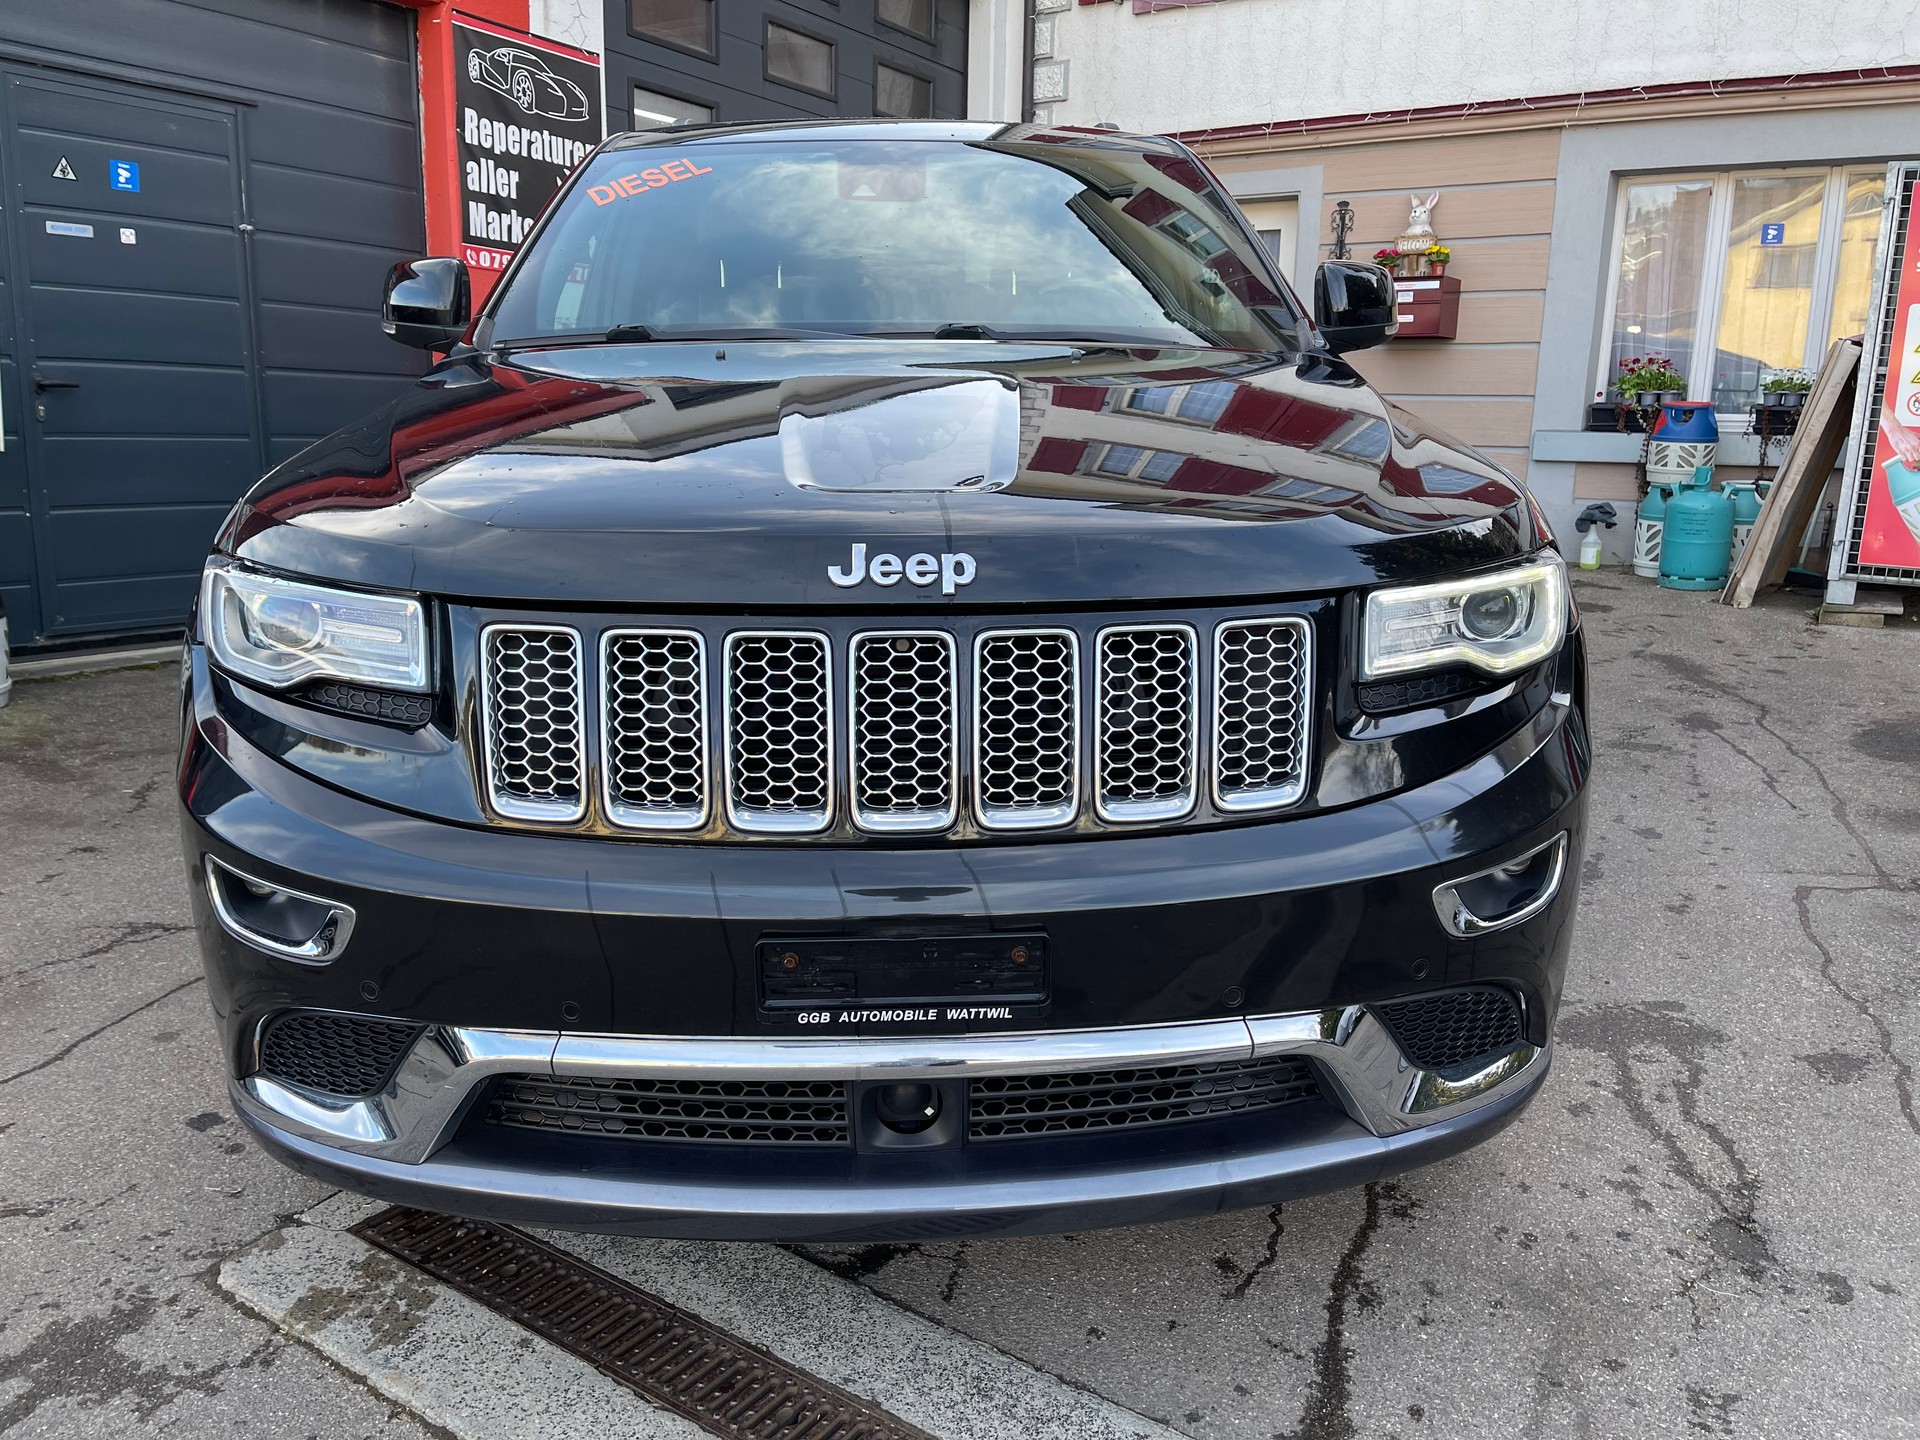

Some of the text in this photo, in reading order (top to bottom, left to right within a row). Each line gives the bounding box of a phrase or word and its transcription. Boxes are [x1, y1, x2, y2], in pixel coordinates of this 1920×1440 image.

[464, 107, 595, 167] Reperature
[466, 157, 519, 199] aller
[586, 158, 713, 207] DIESEL
[1396, 239, 1433, 251] WELCOME
[827, 543, 976, 595] Jeep
[797, 1007, 1013, 1024] GGB AUTOMOBILE WATTWIL
